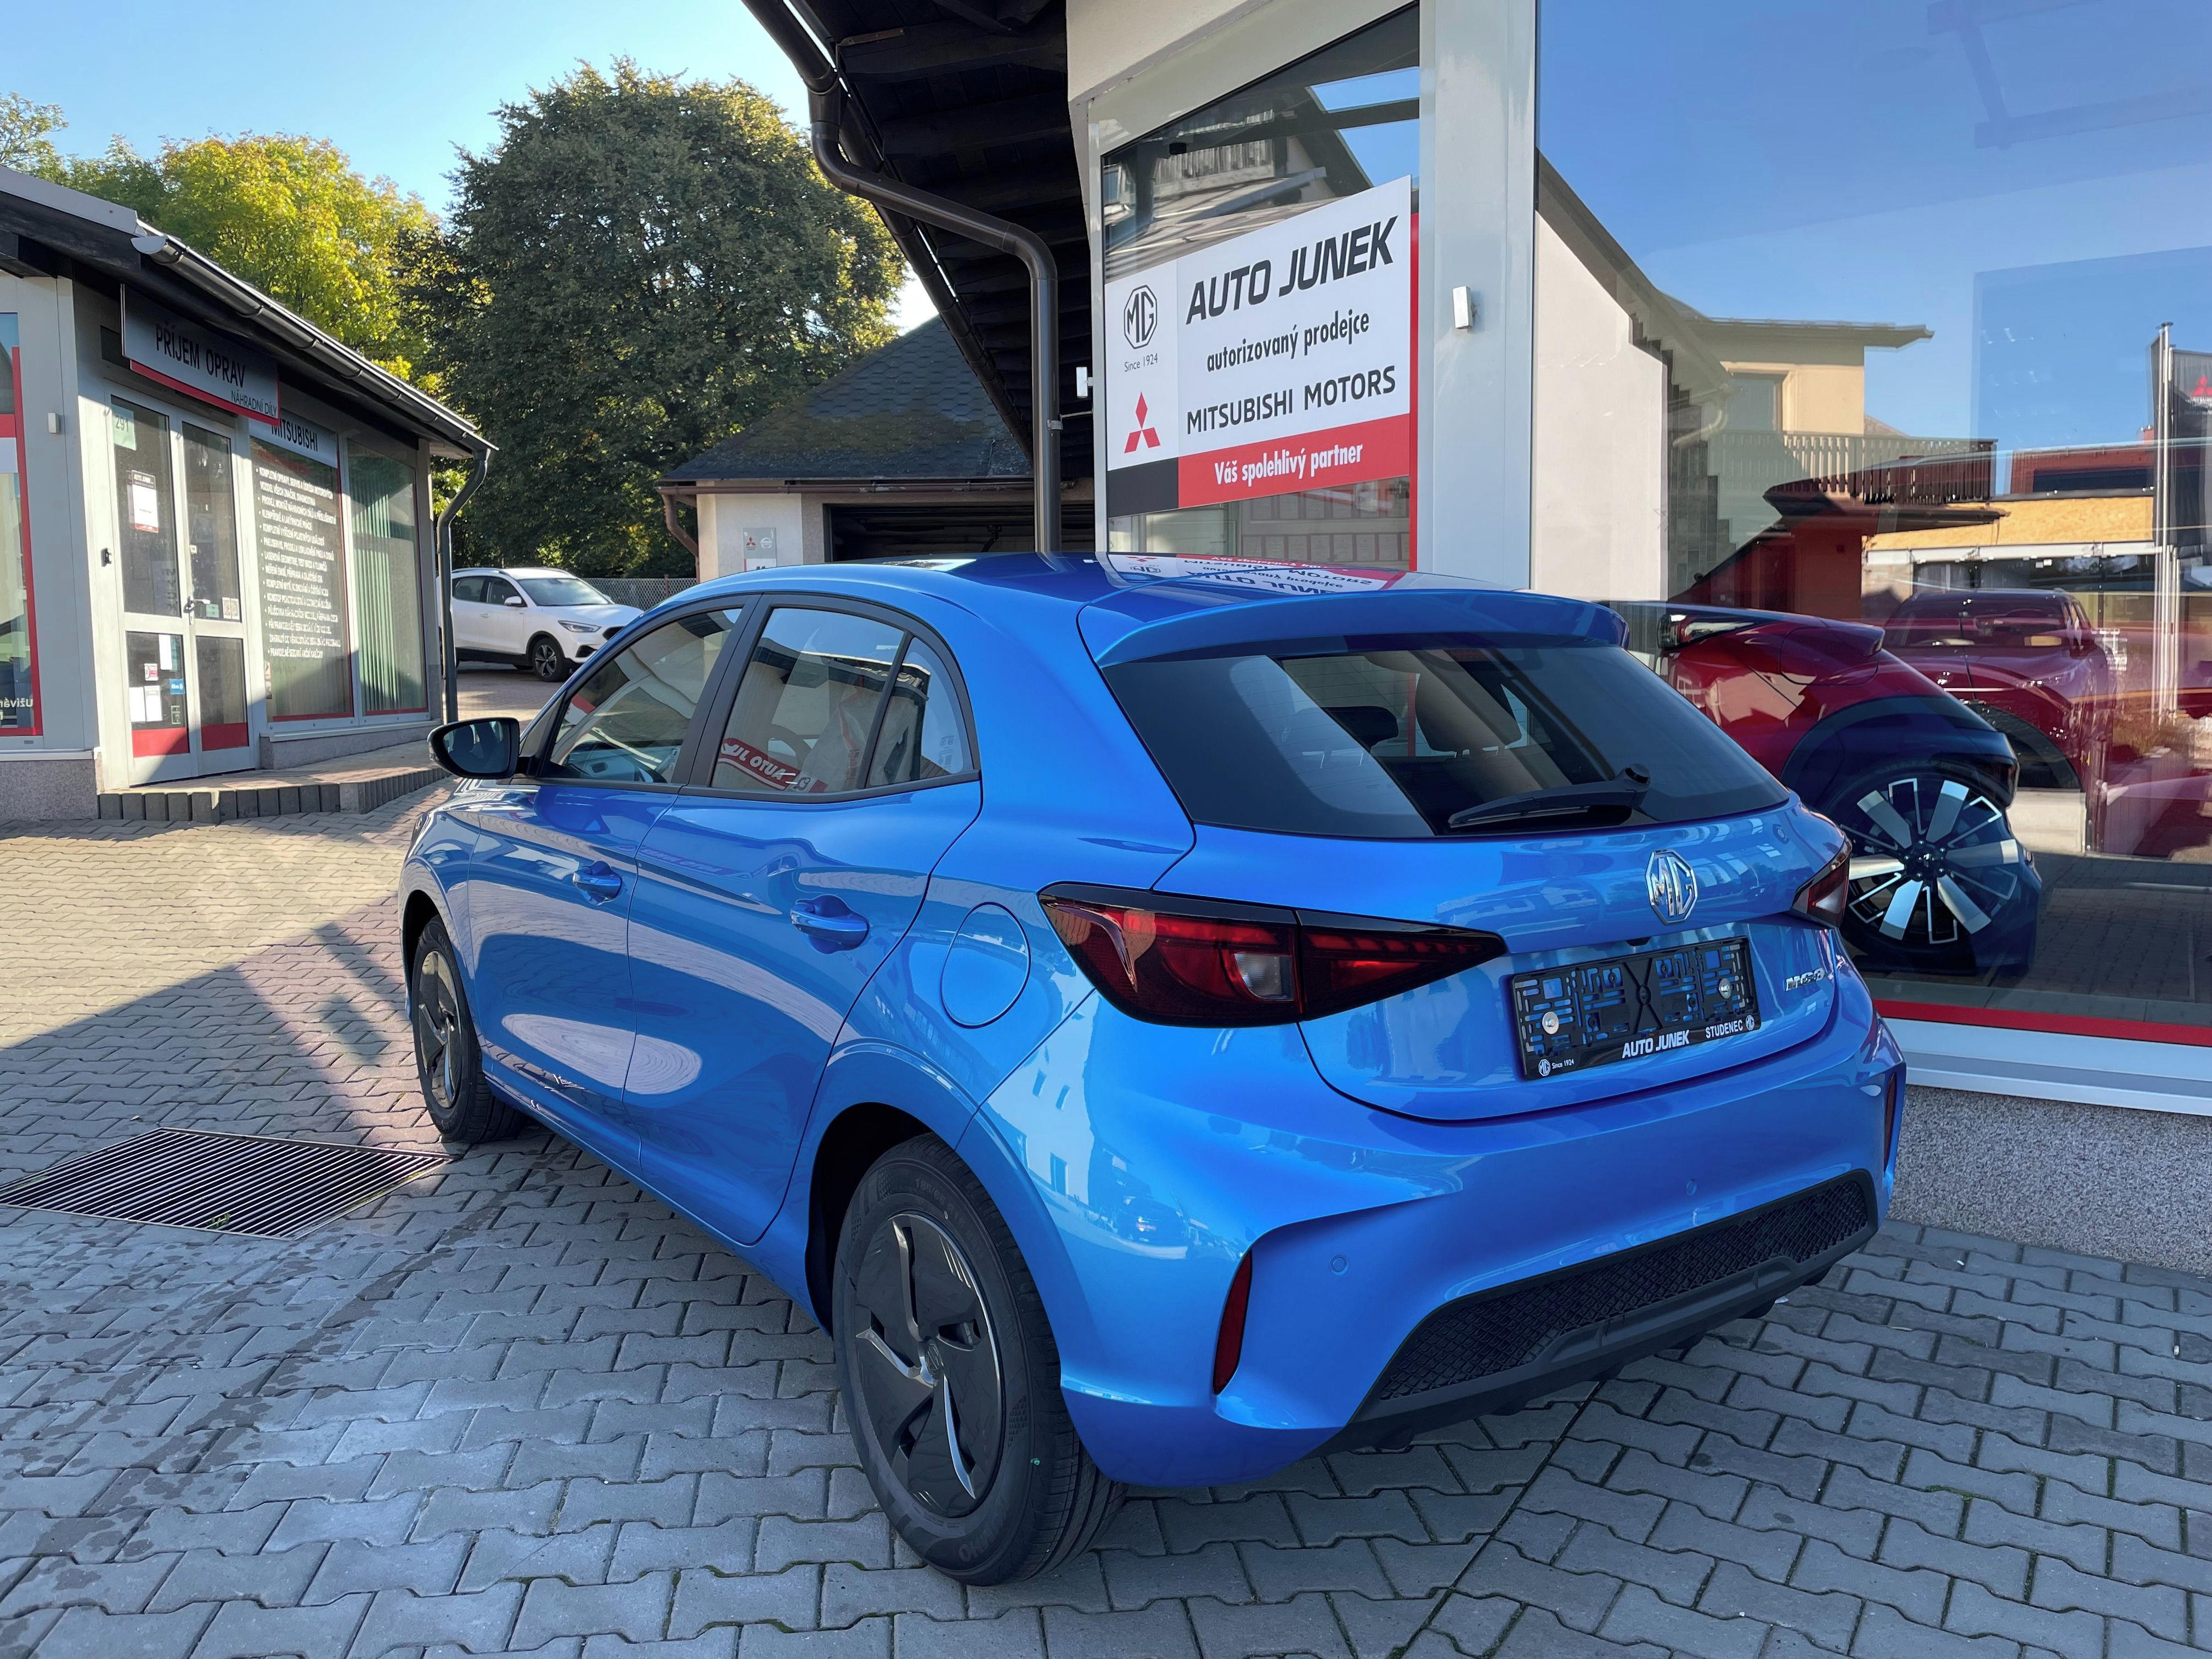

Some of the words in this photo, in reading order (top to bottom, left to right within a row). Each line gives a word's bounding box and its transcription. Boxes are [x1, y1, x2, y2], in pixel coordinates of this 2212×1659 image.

[1185, 259, 1271, 325] AUTO
[1279, 215, 1398, 297] JUNEK
[1126, 288, 1155, 346] MG
[1207, 324, 1299, 373] autorizovaný
[1304, 308, 1369, 356] prodejce
[156, 321, 200, 370] PŘÍJEM
[206, 349, 245, 388] OPRAV
[1124, 360, 1141, 373] Since
[1143, 353, 1158, 367] 1924
[115, 415, 129, 432] 291
[231, 390, 264, 411] NÁHRADNÍ
[264, 400, 278, 417] DÍLY
[1186, 389, 1293, 435] MITSUBISHI
[1304, 365, 1396, 411] MOTORS
[1214, 459, 1238, 485] Váš
[1242, 448, 1306, 488] spolehlivý
[1311, 443, 1363, 476] partner
[1649, 853, 1695, 921] MG
[1622, 1039, 1654, 1059] AUTO
[1655, 1030, 1690, 1052] JUNEK
[1705, 1019, 1743, 1039] STUDENEC
[1539, 1060, 1550, 1075] MG
[1551, 1062, 1563, 1070] Since
[1564, 1058, 1575, 1066] 1924
